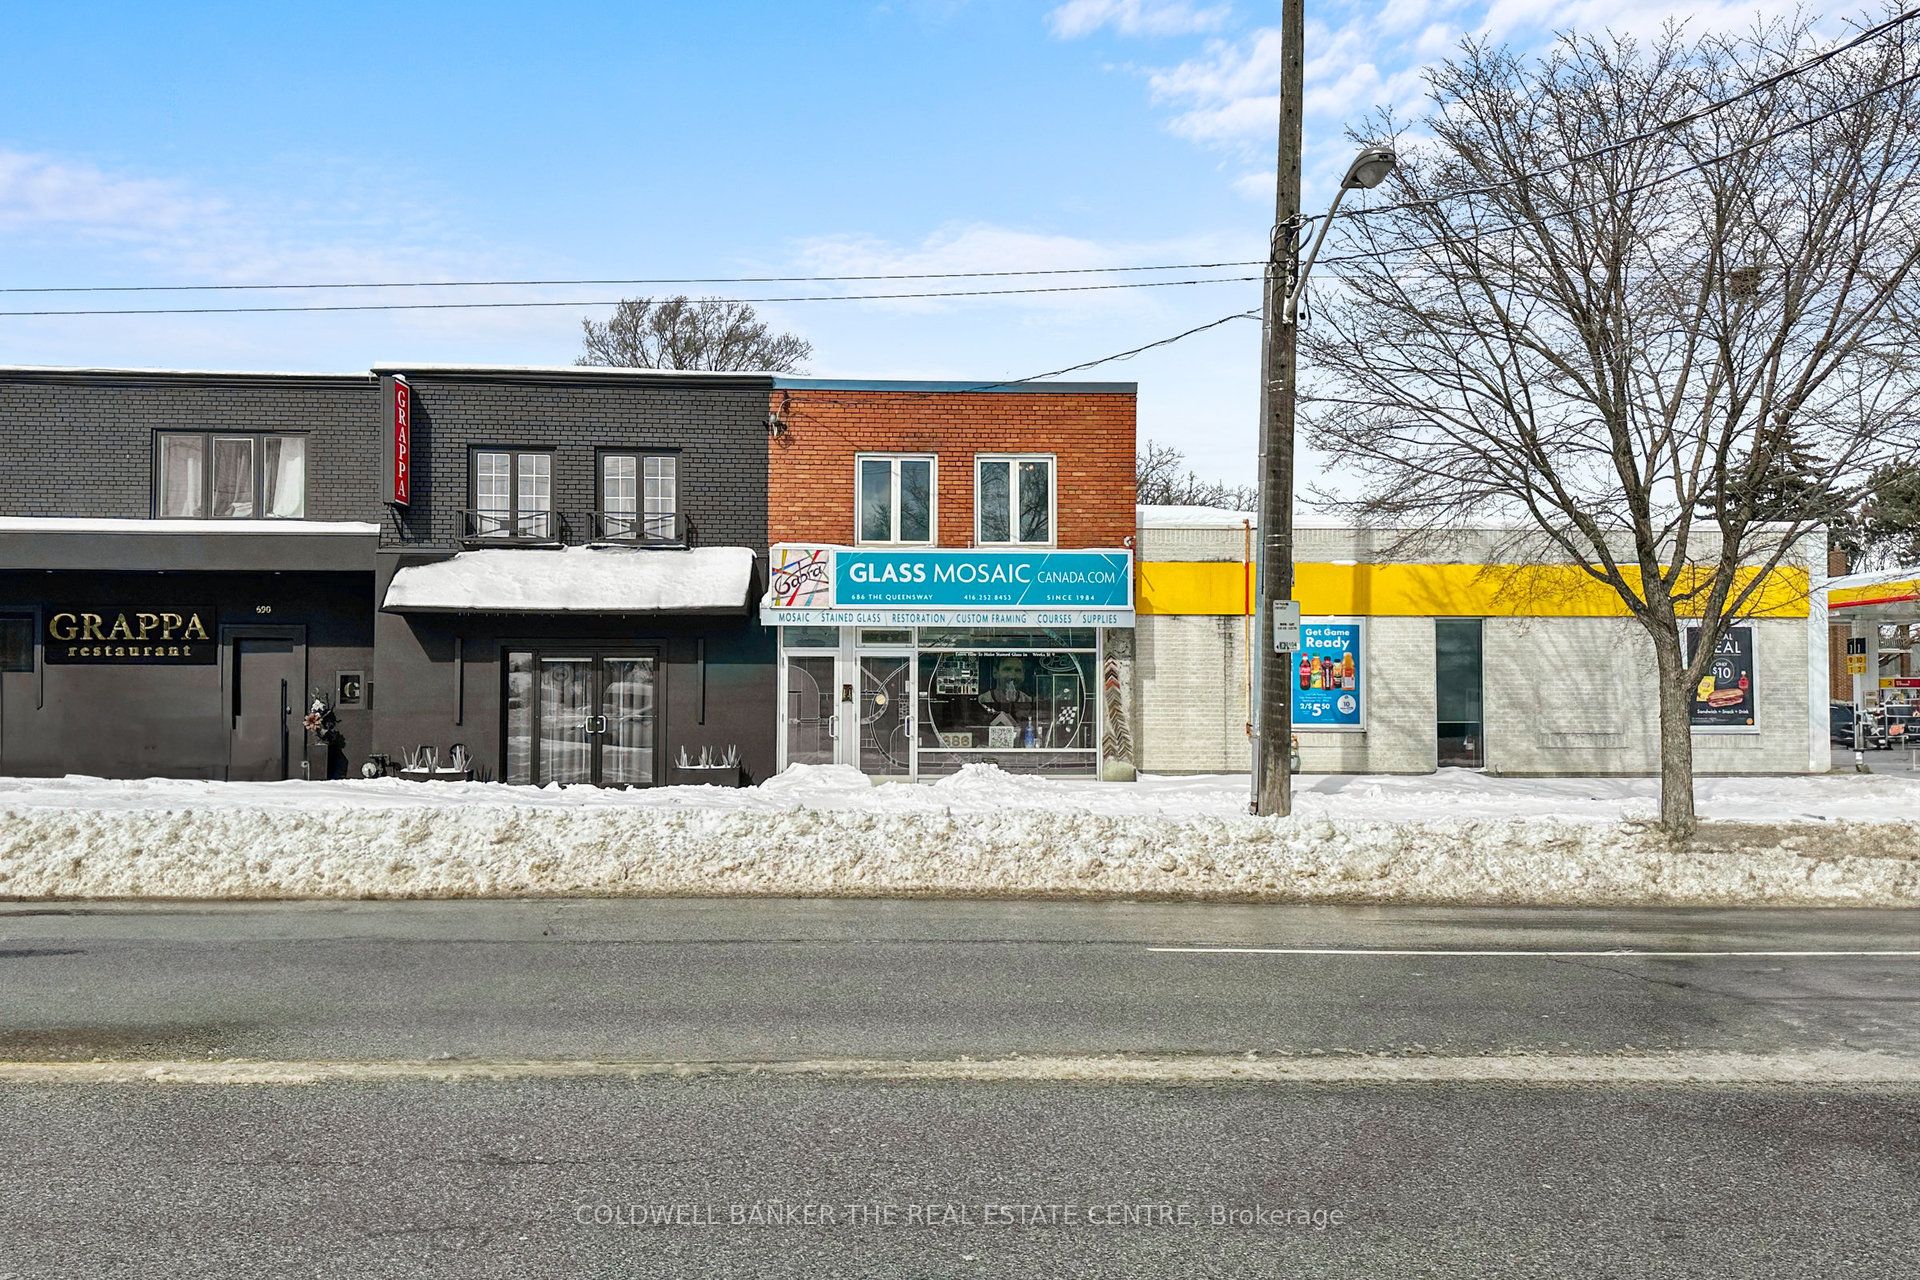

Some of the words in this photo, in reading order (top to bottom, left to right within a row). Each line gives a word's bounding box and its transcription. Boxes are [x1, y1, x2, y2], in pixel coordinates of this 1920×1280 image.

[397, 390, 407, 498] GRAPPA
[849, 562, 927, 583] GLASS
[933, 563, 1031, 583] MOSAIC
[1037, 571, 1116, 584] CANADA.COM
[256, 605, 271, 614] 690
[778, 613, 810, 622] MOSAIC
[821, 613, 854, 623] STAINED
[857, 614, 881, 623] GLASS
[892, 614, 946, 623] RESTORATION
[956, 614, 989, 623] CUSTOM
[992, 614, 1027, 624] FRAMING
[1037, 614, 1072, 624] COURSES
[1082, 614, 1117, 624] SUPPLIES
[49, 613, 210, 641] GRAPPA
[1305, 628, 1322, 636] Get
[1323, 628, 1350, 636] Game
[1306, 637, 1350, 650] Ready
[1714, 641, 1741, 653] EAL
[67, 645, 191, 657] restaurant
[1712, 667, 1731, 678] $10
[344, 682, 360, 697] G
